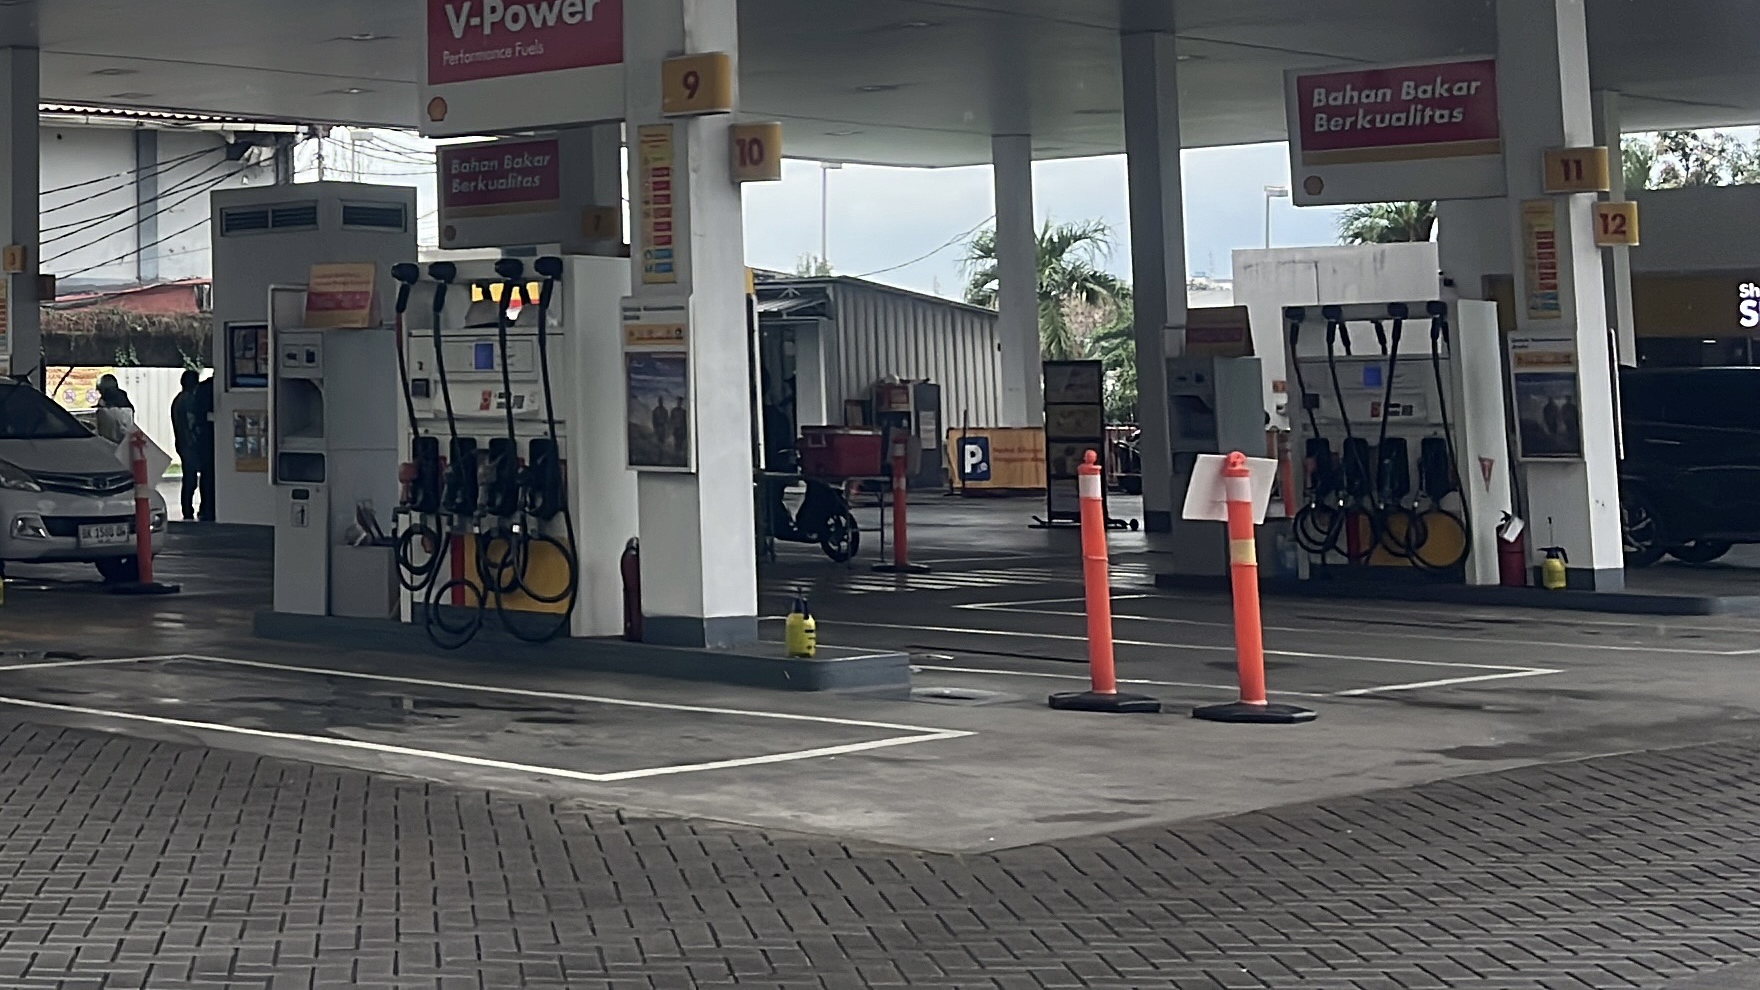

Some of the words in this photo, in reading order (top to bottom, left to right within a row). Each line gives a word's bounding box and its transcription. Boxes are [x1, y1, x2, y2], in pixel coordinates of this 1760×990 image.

[443, 47, 512, 66] Performance
[515, 39, 544, 57] Fuels
[682, 70, 700, 100] 9
[1313, 83, 1392, 108] Bahan
[1401, 75, 1481, 101] Bakar
[1315, 104, 1464, 132] Berkualitas
[451, 156, 498, 174] Bahan
[504, 152, 551, 170] Bakar
[735, 137, 764, 167] 10
[452, 173, 540, 193] Berkualitas
[1560, 158, 1583, 181] 11
[1599, 212, 1627, 236] 12
[965, 444, 982, 473] P
